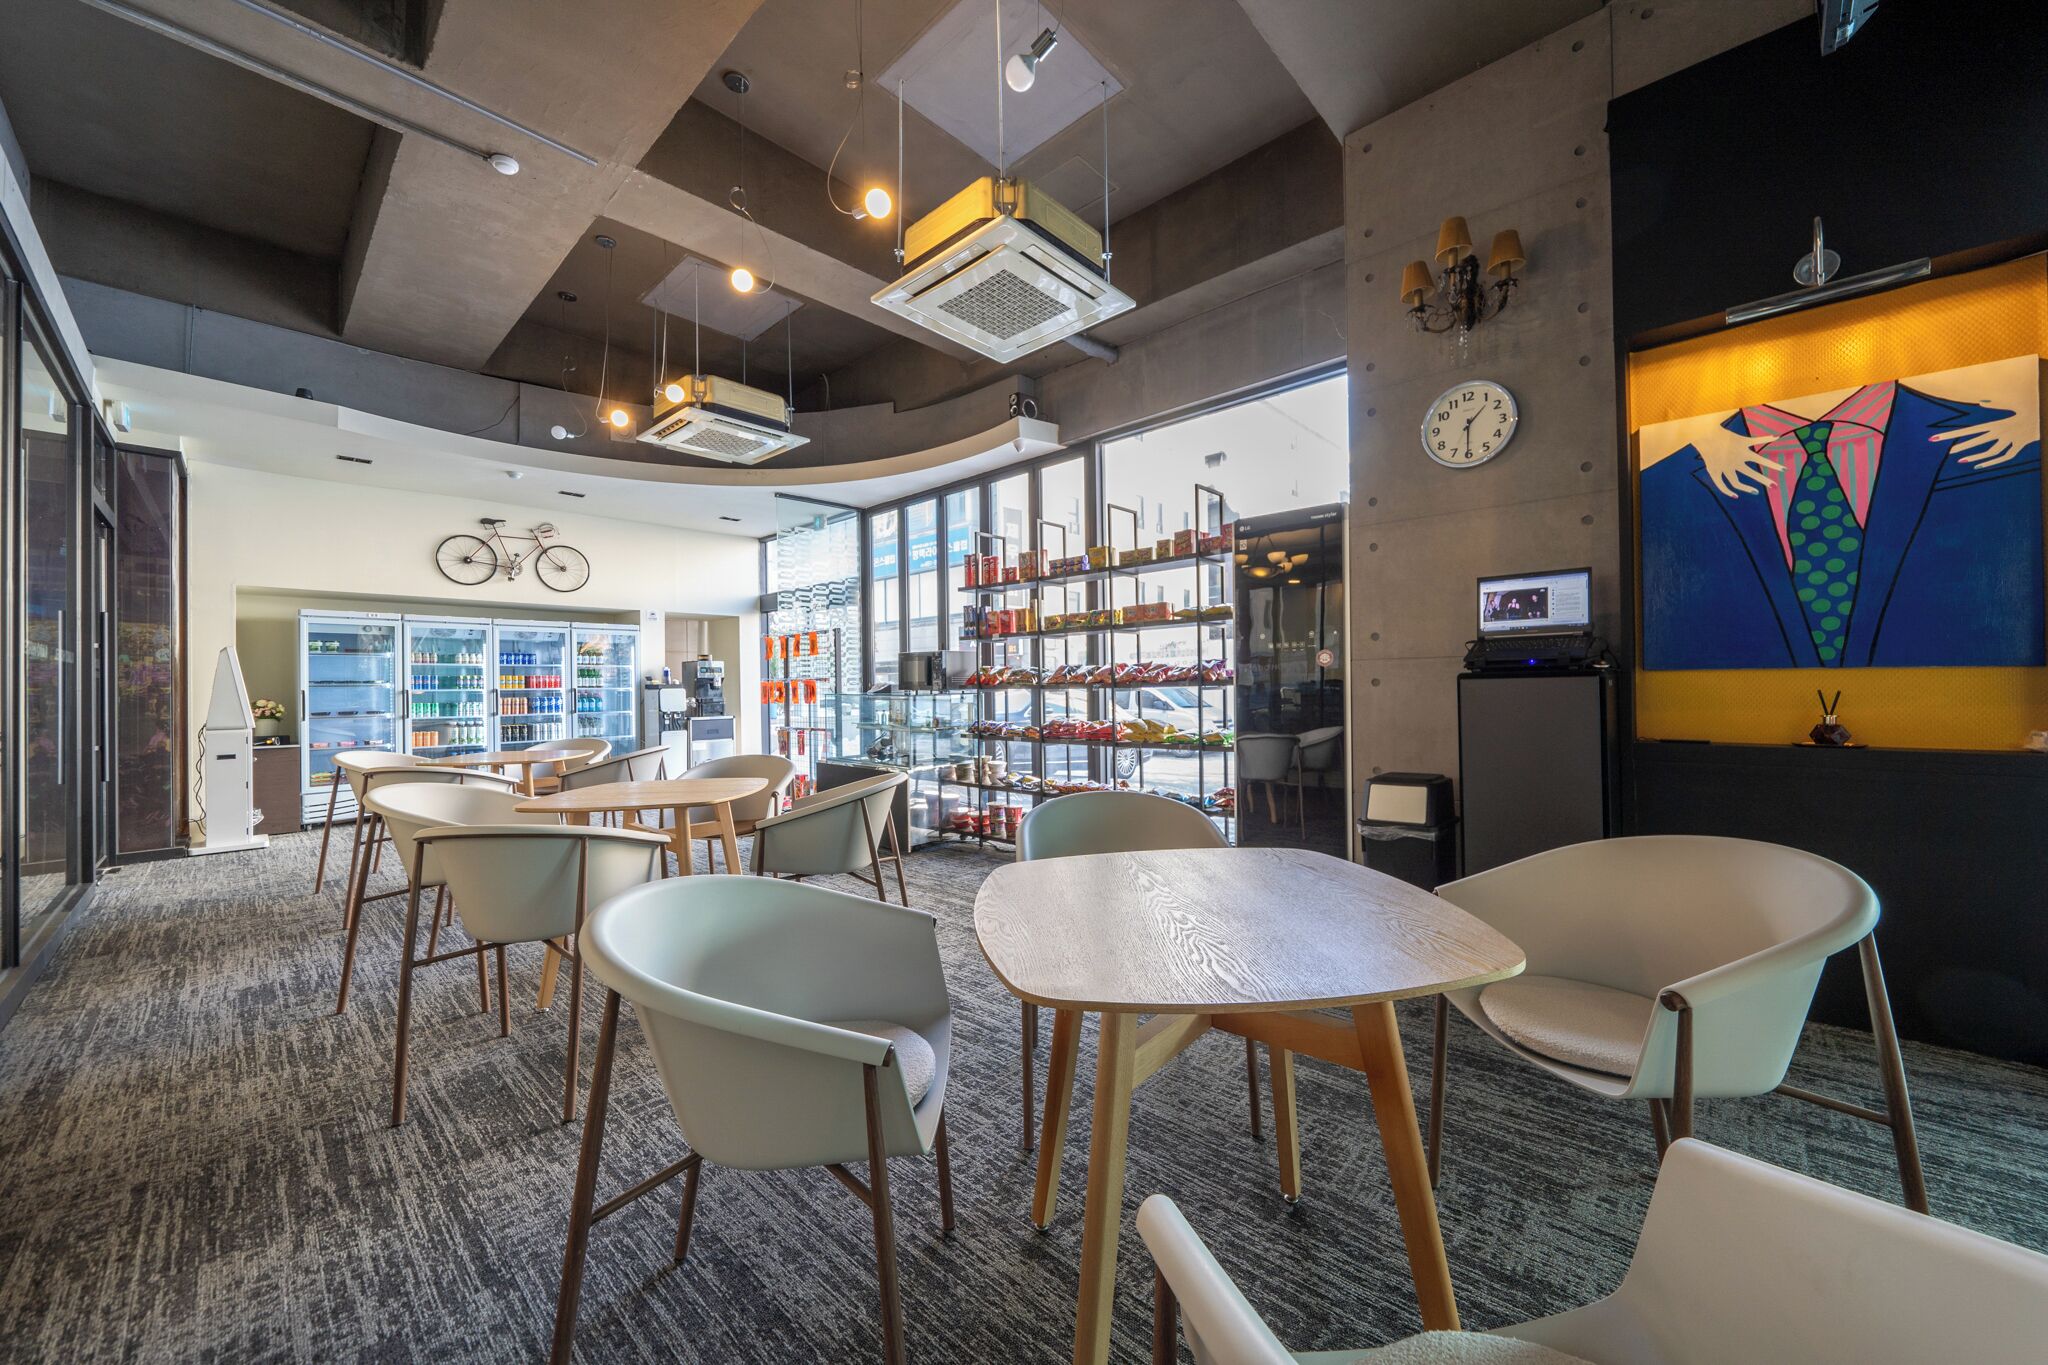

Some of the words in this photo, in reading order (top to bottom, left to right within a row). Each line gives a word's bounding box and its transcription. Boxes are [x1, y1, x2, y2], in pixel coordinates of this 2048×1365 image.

[1462, 391, 1475, 402] 12
[1484, 392, 1489, 402] 1
[1449, 399, 1458, 410] 11
[1493, 399, 1502, 410] 2
[1437, 411, 1450, 422] 10
[1499, 413, 1507, 424] 3
[1432, 427, 1440, 437] 9
[1493, 428, 1502, 438] 4
[1437, 440, 1446, 451] 8
[1482, 441, 1490, 452] 5
[1450, 448, 1458, 457] 7
[1464, 448, 1473, 459] 6
